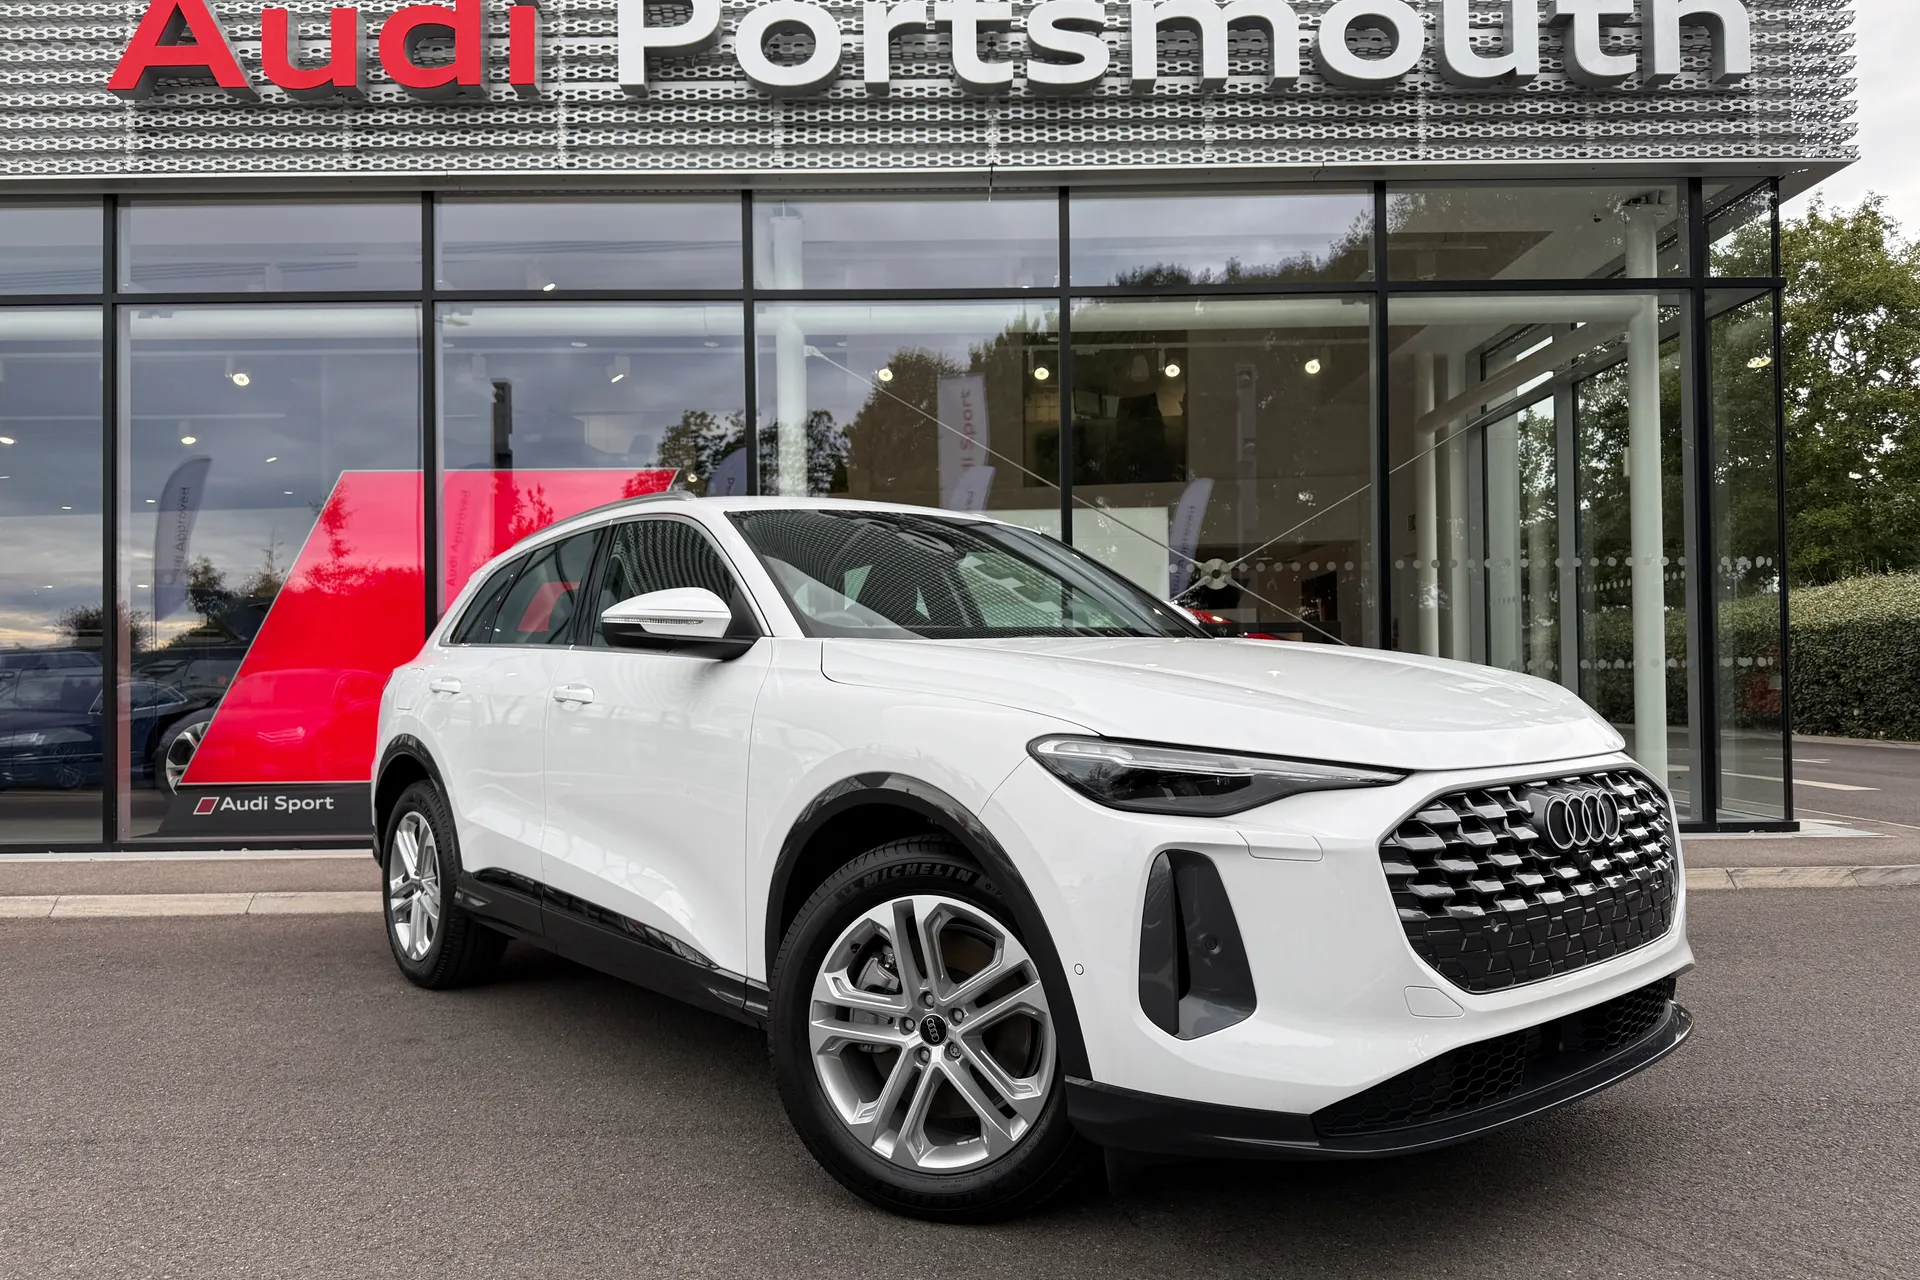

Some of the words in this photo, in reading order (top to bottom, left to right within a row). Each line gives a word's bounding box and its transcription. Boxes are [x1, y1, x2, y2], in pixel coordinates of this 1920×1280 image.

[107, 0, 539, 92] Audi
[617, 0, 1751, 91] Portsmouth
[960, 387, 977, 452] Sport
[175, 487, 190, 547] Approved
[449, 490, 471, 552] Approved
[446, 556, 458, 587] Audi
[220, 796, 268, 811] Audi
[274, 796, 335, 814] Sport
[863, 863, 974, 888] MICHELIN
